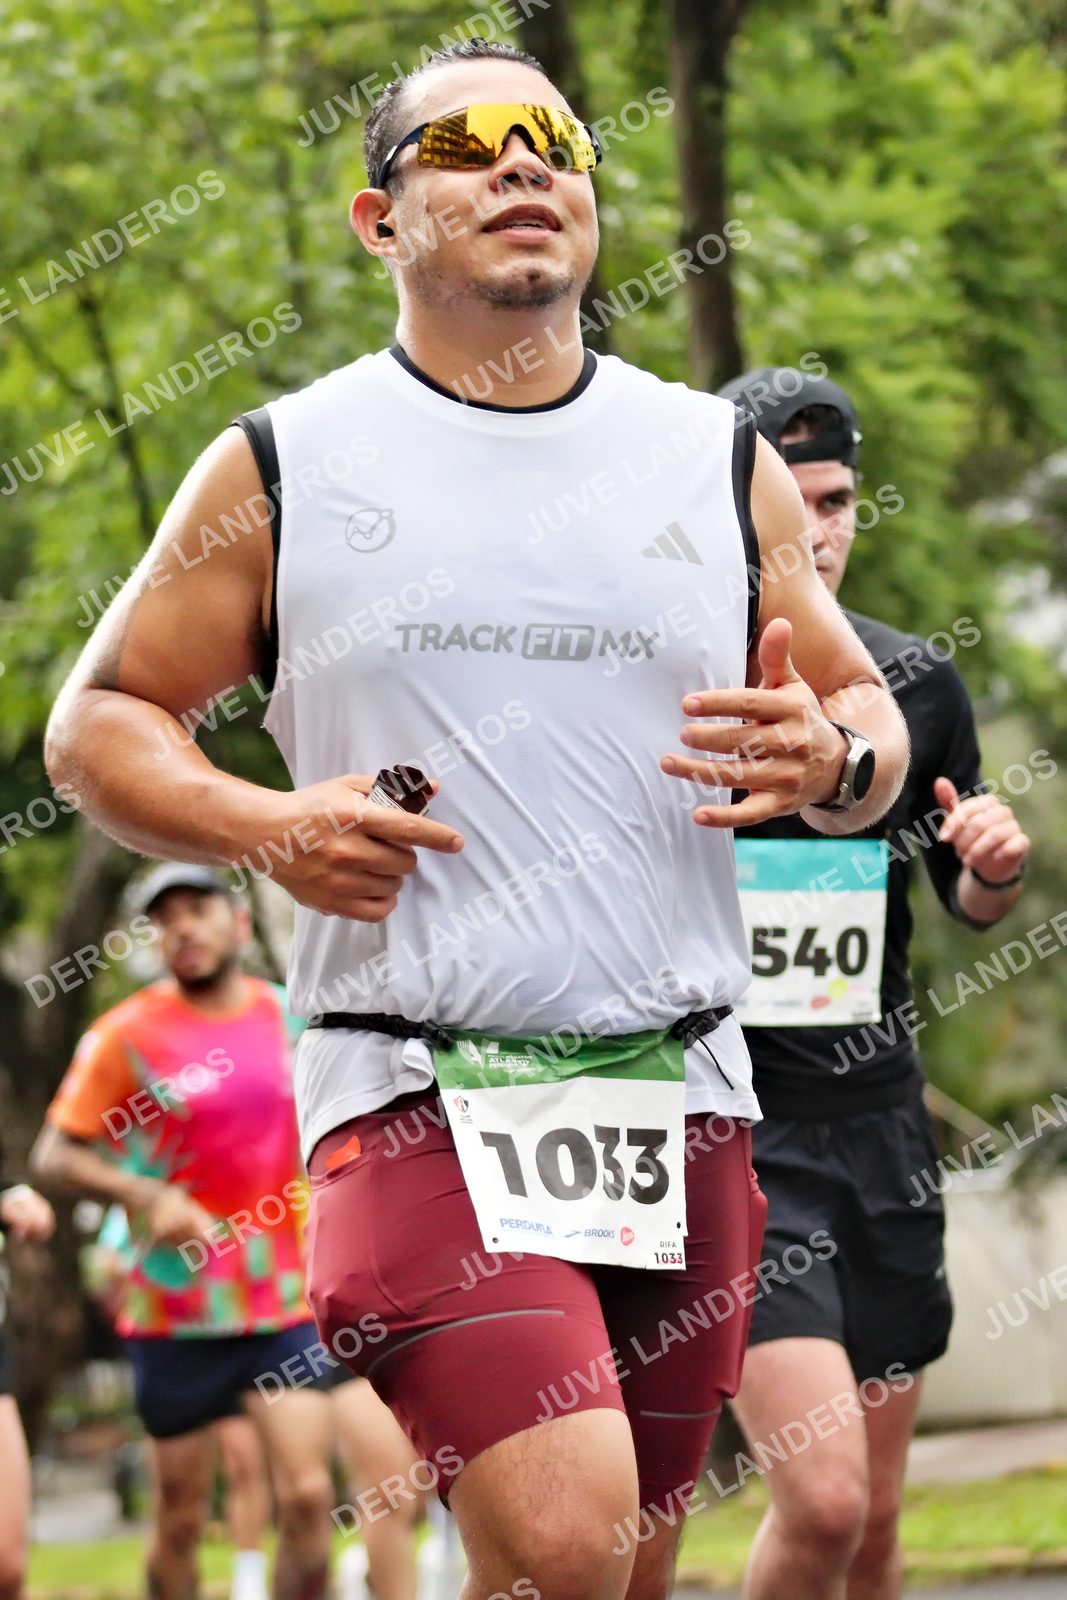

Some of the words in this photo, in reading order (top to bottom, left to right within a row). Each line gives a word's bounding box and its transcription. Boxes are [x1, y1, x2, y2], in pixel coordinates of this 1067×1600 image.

[395, 623, 517, 653] TRACK
[526, 627, 590, 657] FIT
[598, 629, 660, 659] MX
[479, 1124, 670, 1205] 1033
[500, 1217, 553, 1236] PERDURA
[584, 1228, 615, 1239] BROOKS
[659, 1241, 677, 1249] RIFA
[654, 1252, 683, 1265] 1033
